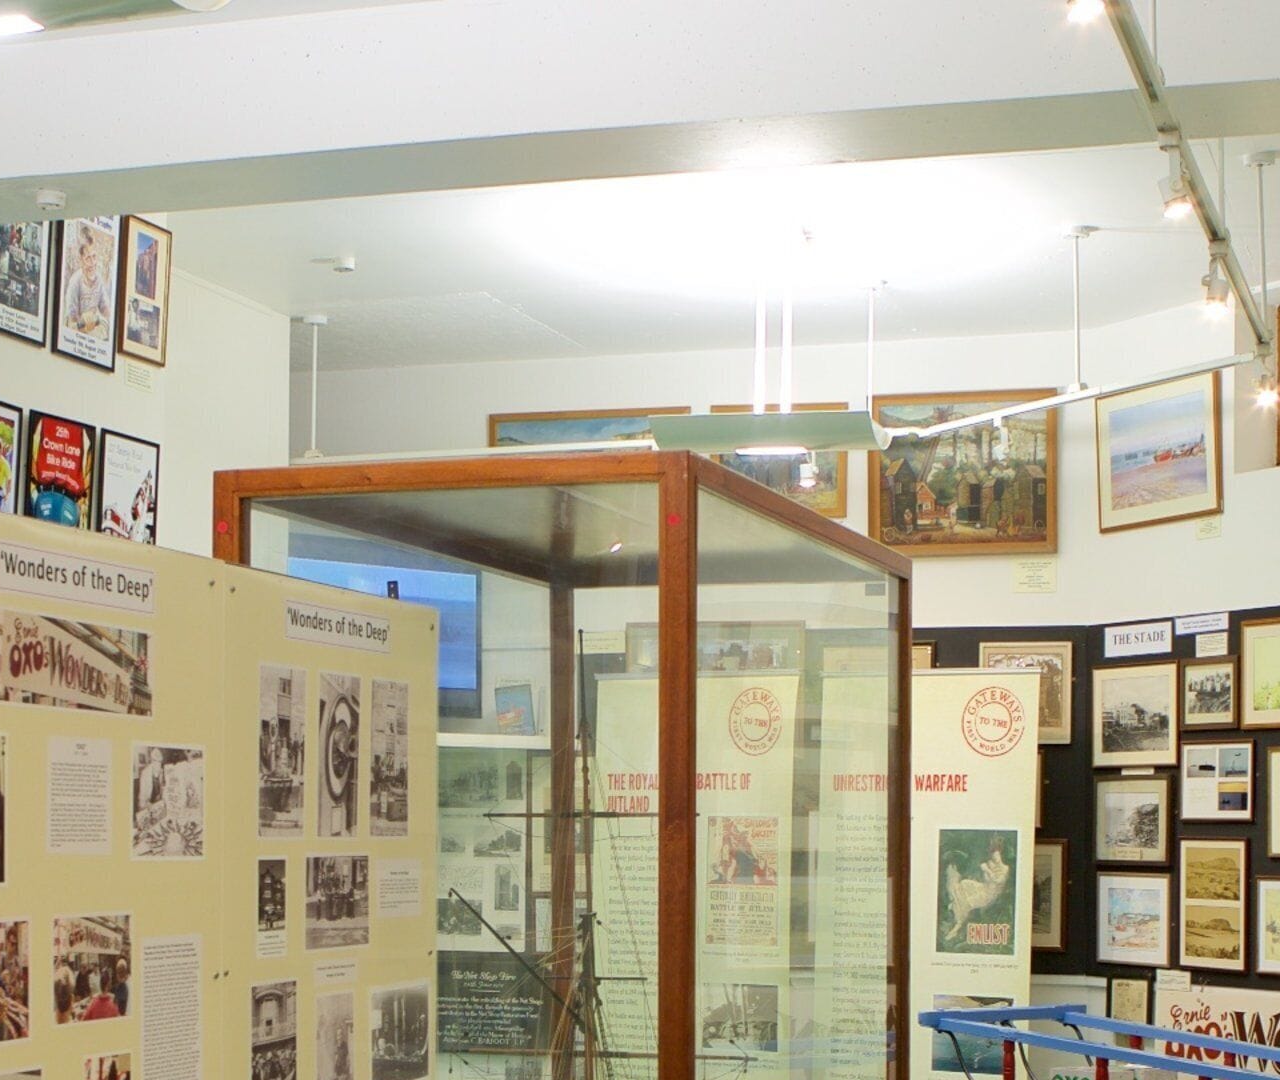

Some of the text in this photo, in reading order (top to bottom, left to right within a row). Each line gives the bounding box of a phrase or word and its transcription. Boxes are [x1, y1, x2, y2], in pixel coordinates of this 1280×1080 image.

[42, 438, 64, 453] Crown
[72, 565, 87, 586] of
[91, 568, 113, 590] the
[335, 617, 345, 635] of
[347, 618, 363, 638] the
[1113, 630, 1166, 645] THE STADE
[734, 690, 780, 722] GATEWAYS
[969, 690, 1023, 723] GATEWAYS
[743, 716, 754, 726] TO
[979, 716, 1009, 729] TO THE
[966, 720, 977, 743] FIRST
[607, 773, 751, 790] THE ROYAL BATTLE OF
[914, 774, 968, 792] WARFARE
[607, 795, 650, 812] JUTLAND
[967, 922, 1010, 945] ENLIST
[1170, 1002, 1211, 1028] Ernie
